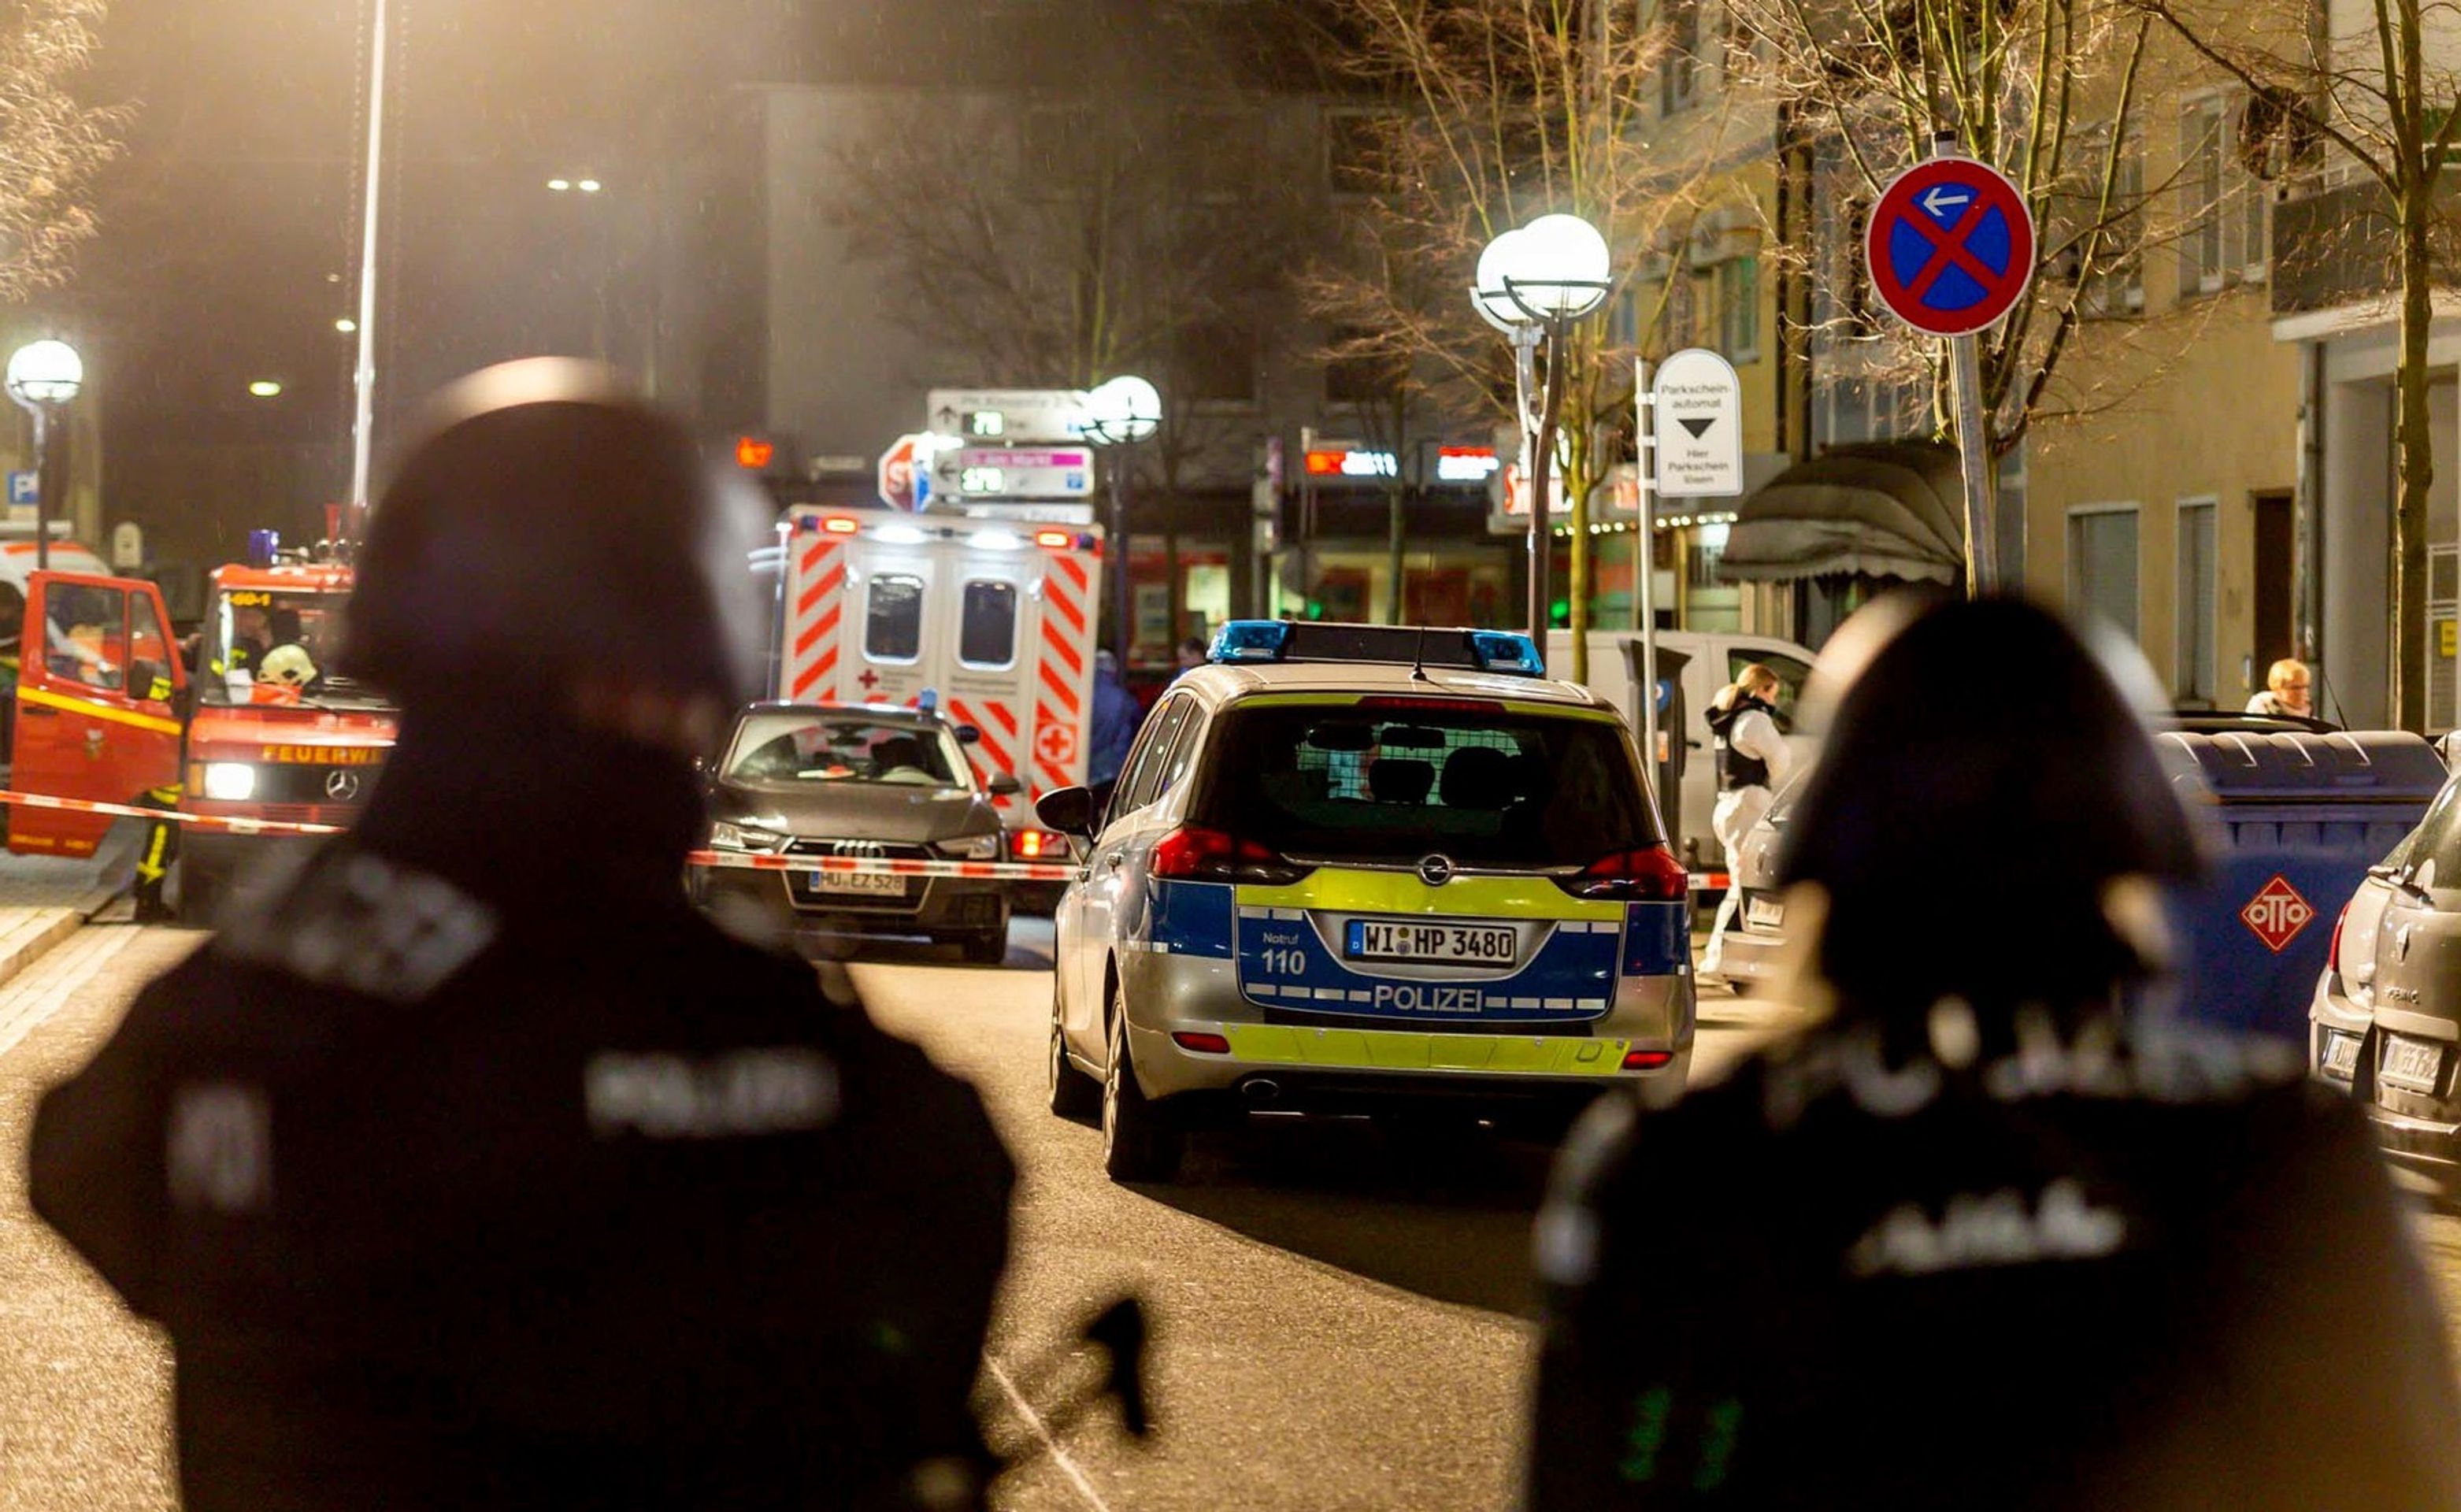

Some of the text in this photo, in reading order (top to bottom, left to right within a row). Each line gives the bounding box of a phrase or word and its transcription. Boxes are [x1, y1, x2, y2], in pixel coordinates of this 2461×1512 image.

[1672, 398, 1722, 410] automat
[1687, 449, 1709, 458] Hier
[1668, 461, 1729, 472] Parkschein
[2248, 895, 2306, 932] OTTO
[1263, 932, 1299, 944] Notruf
[1366, 925, 1393, 952] WI
[1414, 928, 1445, 954] HP
[1452, 930, 1512, 958] 3480
[1262, 948, 1306, 976] 110
[1374, 984, 1483, 1013] POLIZEI
